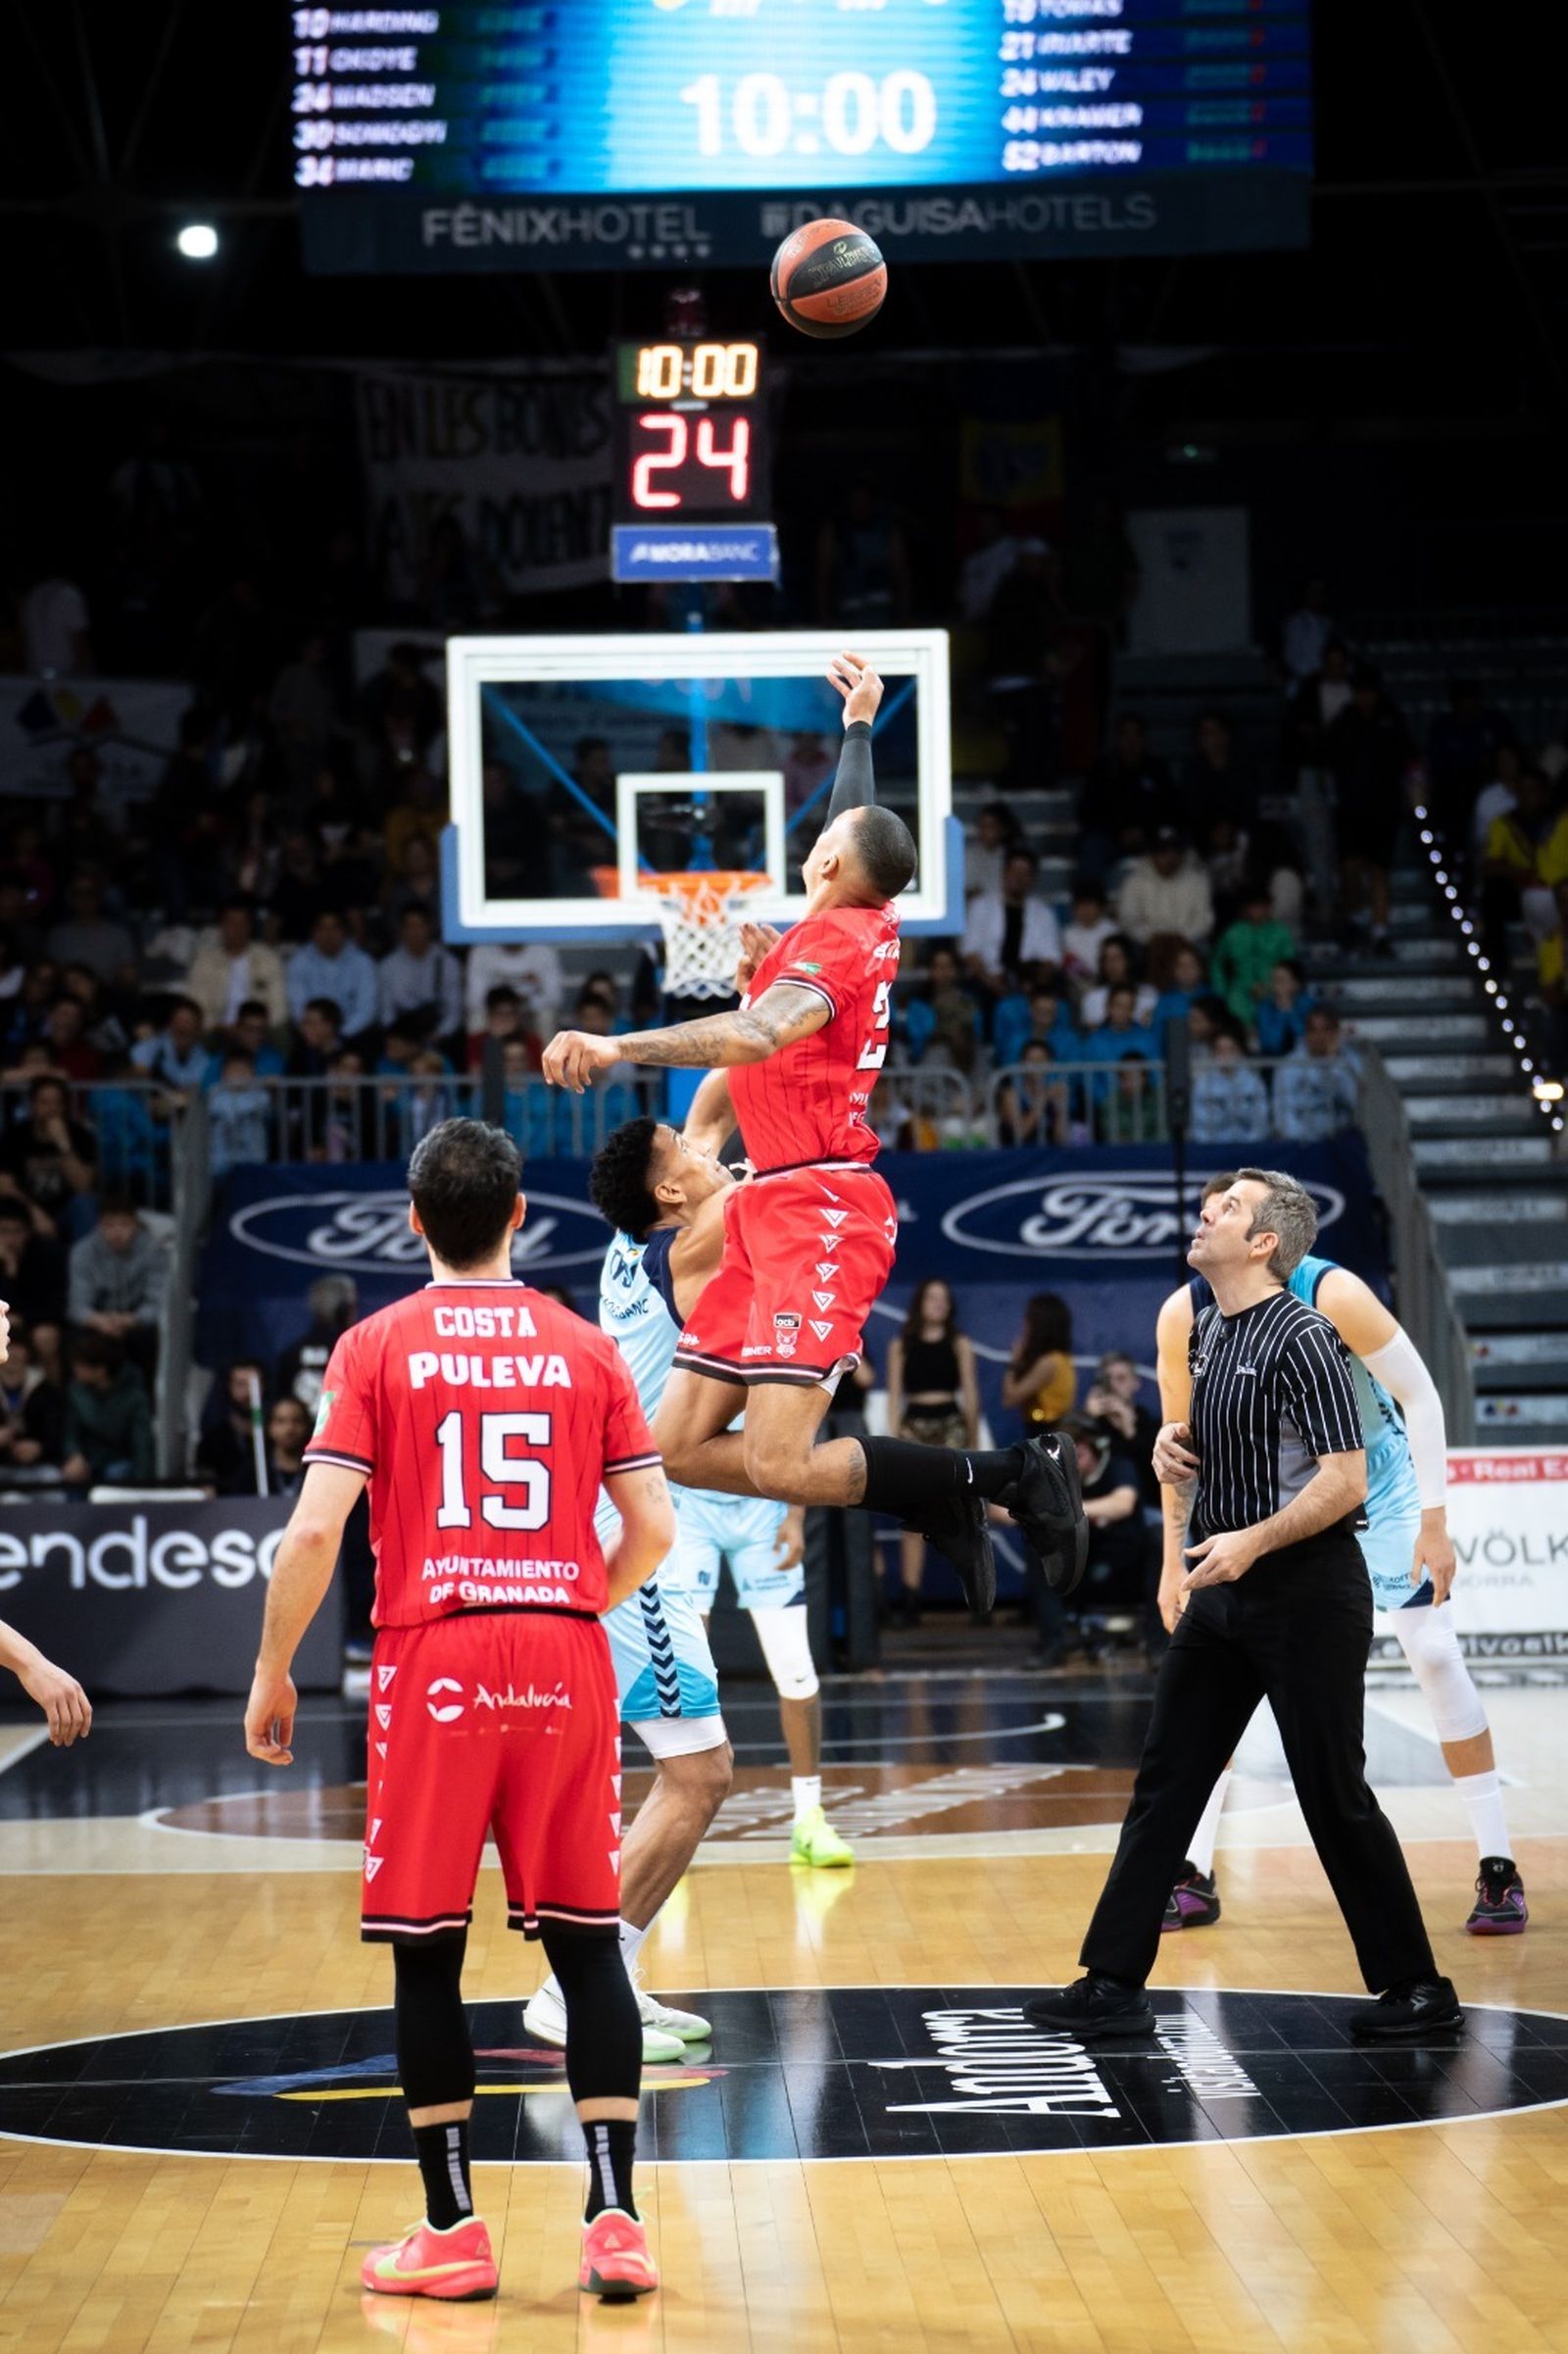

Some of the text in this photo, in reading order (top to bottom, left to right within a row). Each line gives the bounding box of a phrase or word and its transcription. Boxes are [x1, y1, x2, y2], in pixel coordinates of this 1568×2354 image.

[295, 46, 329, 75] 11
[999, 30, 1036, 61] 21
[681, 69, 937, 157] 10:00
[638, 343, 759, 398] 10:00
[632, 414, 751, 509] 24
[308, 1202, 559, 1261] Fod
[1020, 1184, 1201, 1248] For
[433, 1306, 538, 1338] COSTA
[408, 1351, 572, 1390] PULEVA
[436, 1410, 552, 1531] 15
[1544, 1456, 1568, 1479] E
[421, 1554, 580, 1582] AYUNTAMIENTO
[459, 1580, 571, 1605] GRANADA
[473, 1682, 573, 1710] Andalucía
